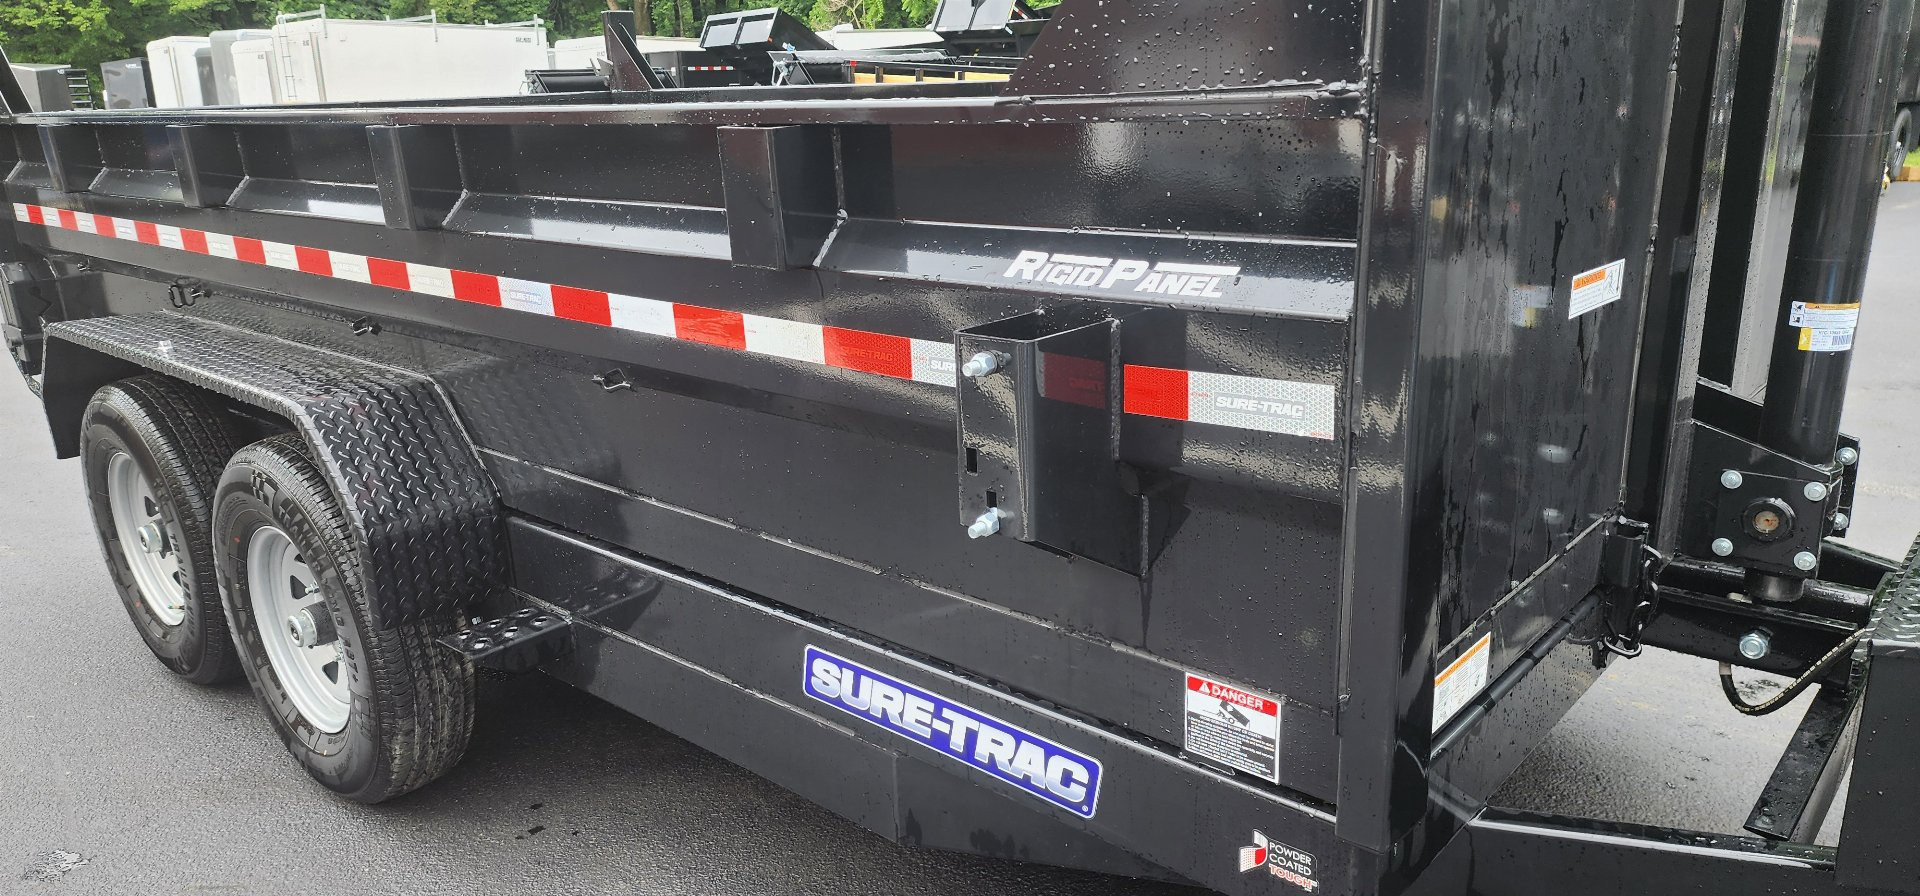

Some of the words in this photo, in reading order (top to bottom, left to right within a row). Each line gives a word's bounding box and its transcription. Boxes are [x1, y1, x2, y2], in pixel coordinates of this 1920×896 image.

[1003, 250, 1108, 287] RIGID
[1099, 258, 1226, 299] PANEL
[1216, 396, 1304, 419] SURE-TRAC
[1212, 685, 1264, 711] DANGER
[811, 657, 1090, 803] SURE-TRAC
[1269, 841, 1312, 866] POWDER
[1269, 853, 1312, 876] COATED
[1268, 862, 1313, 890] TOUGH
